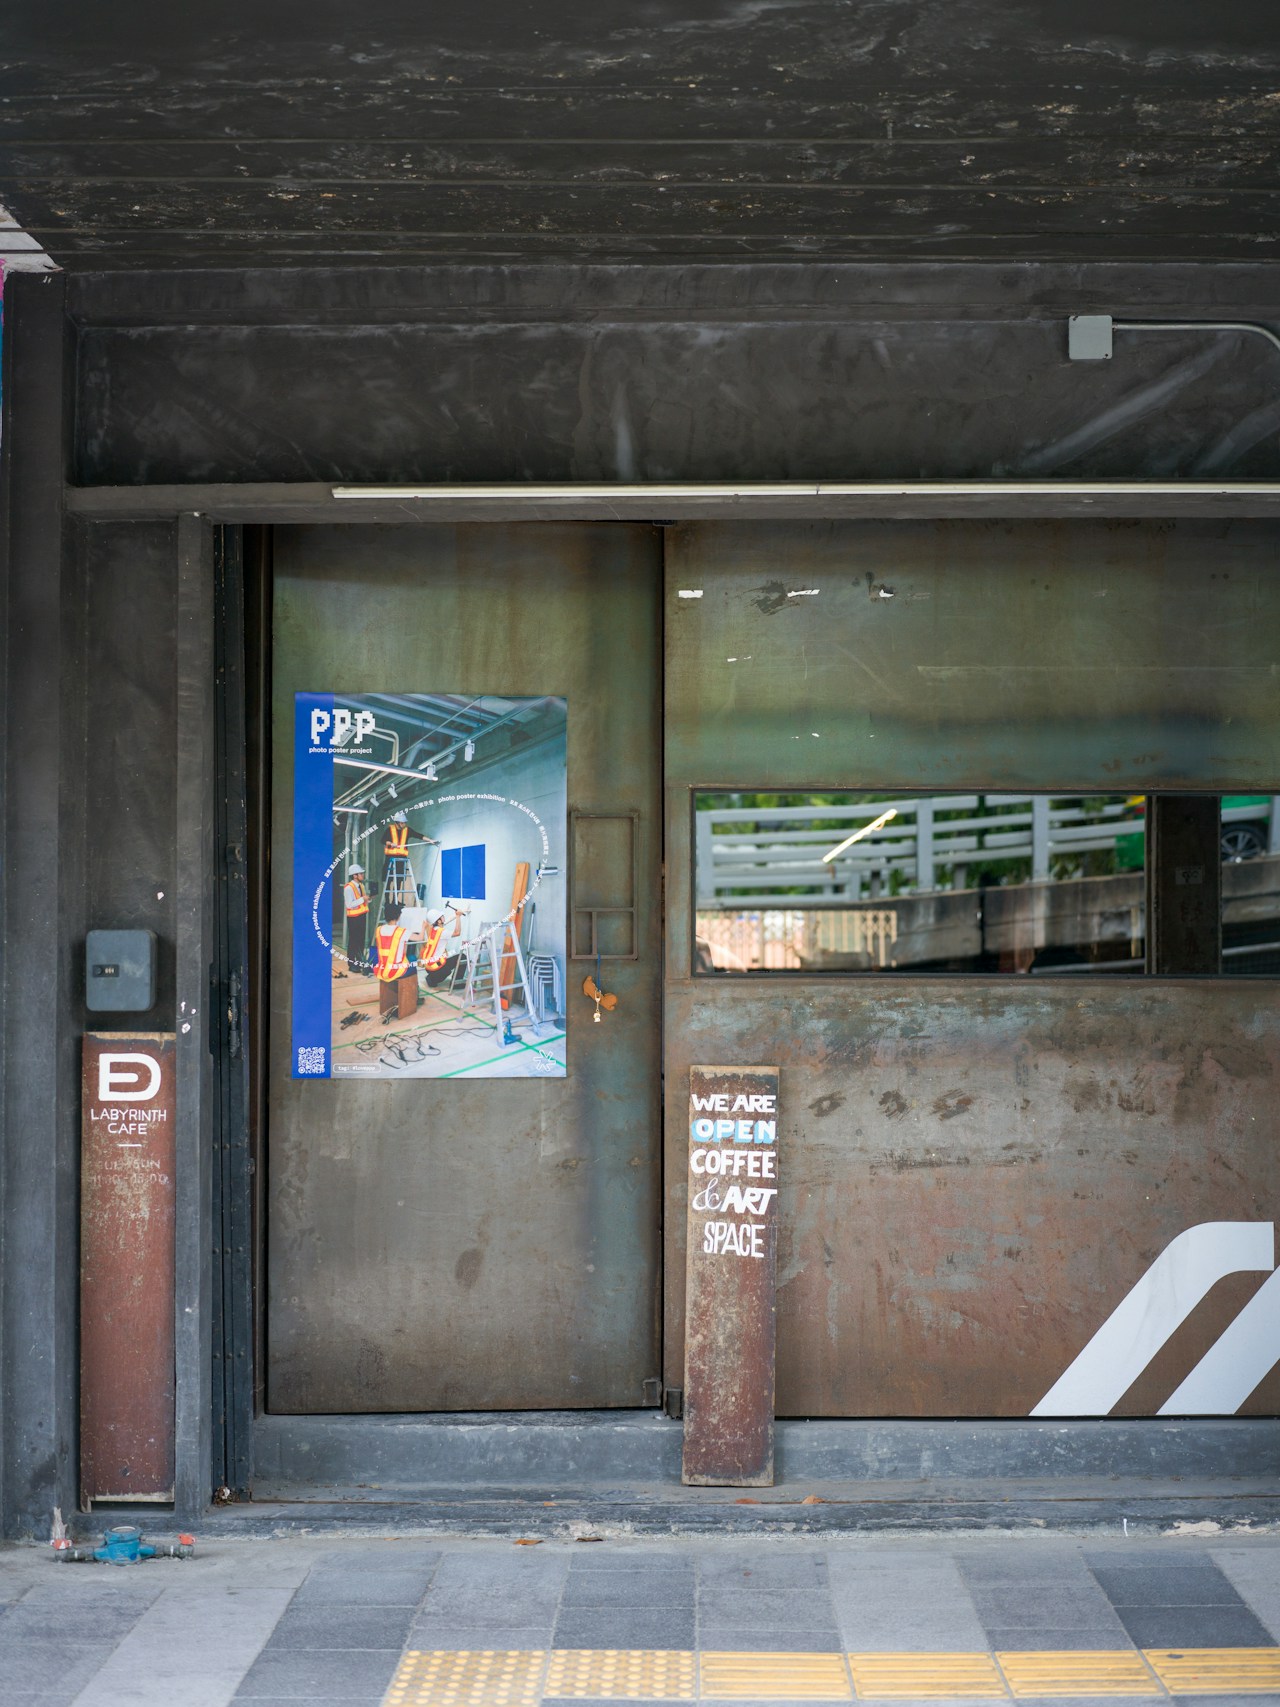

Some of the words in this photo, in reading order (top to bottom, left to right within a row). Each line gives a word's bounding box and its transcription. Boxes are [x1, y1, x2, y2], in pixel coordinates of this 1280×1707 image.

[349, 747, 373, 755] project
[438, 795, 456, 804] photo
[456, 793, 476, 801] poster
[476, 793, 506, 803] exhibition
[313, 881, 326, 910] exhibition
[312, 910, 321, 930] poster
[501, 908, 517, 922] photo
[316, 930, 330, 947] photo
[691, 1093, 729, 1112] WE
[731, 1094, 776, 1113] ARE
[90, 1108, 167, 1122] LABYRINTH
[107, 1122, 148, 1135] CAFE
[691, 1118, 776, 1144] OPEN
[690, 1149, 776, 1178] COFFEE
[692, 1177, 723, 1211] &
[720, 1186, 777, 1215] ART
[703, 1221, 765, 1258] SPACE
